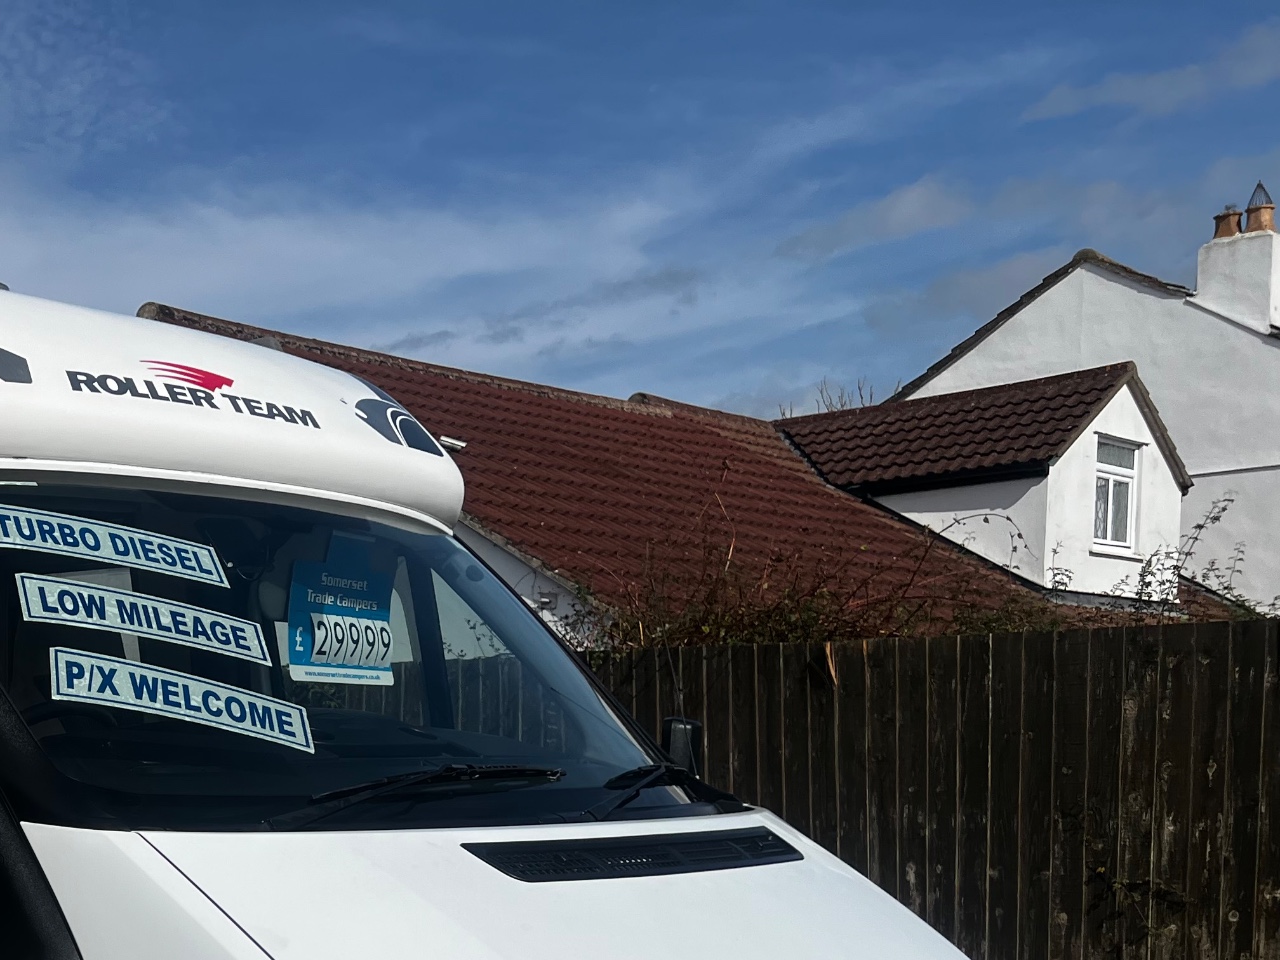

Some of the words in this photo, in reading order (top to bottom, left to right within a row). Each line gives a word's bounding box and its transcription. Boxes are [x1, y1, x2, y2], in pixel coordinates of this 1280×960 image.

[65, 370, 220, 409] ROLLER
[221, 393, 321, 429] TEAM
[108, 532, 213, 576] DIESEL
[307, 589, 334, 605] Trade
[337, 594, 378, 611] Campers
[321, 572, 368, 591] Somerset
[37, 586, 106, 621] LOW
[119, 599, 251, 652] MILEAGE
[315, 620, 391, 661] 29999
[65, 661, 119, 697] P/X
[128, 672, 297, 738] WELCOME
